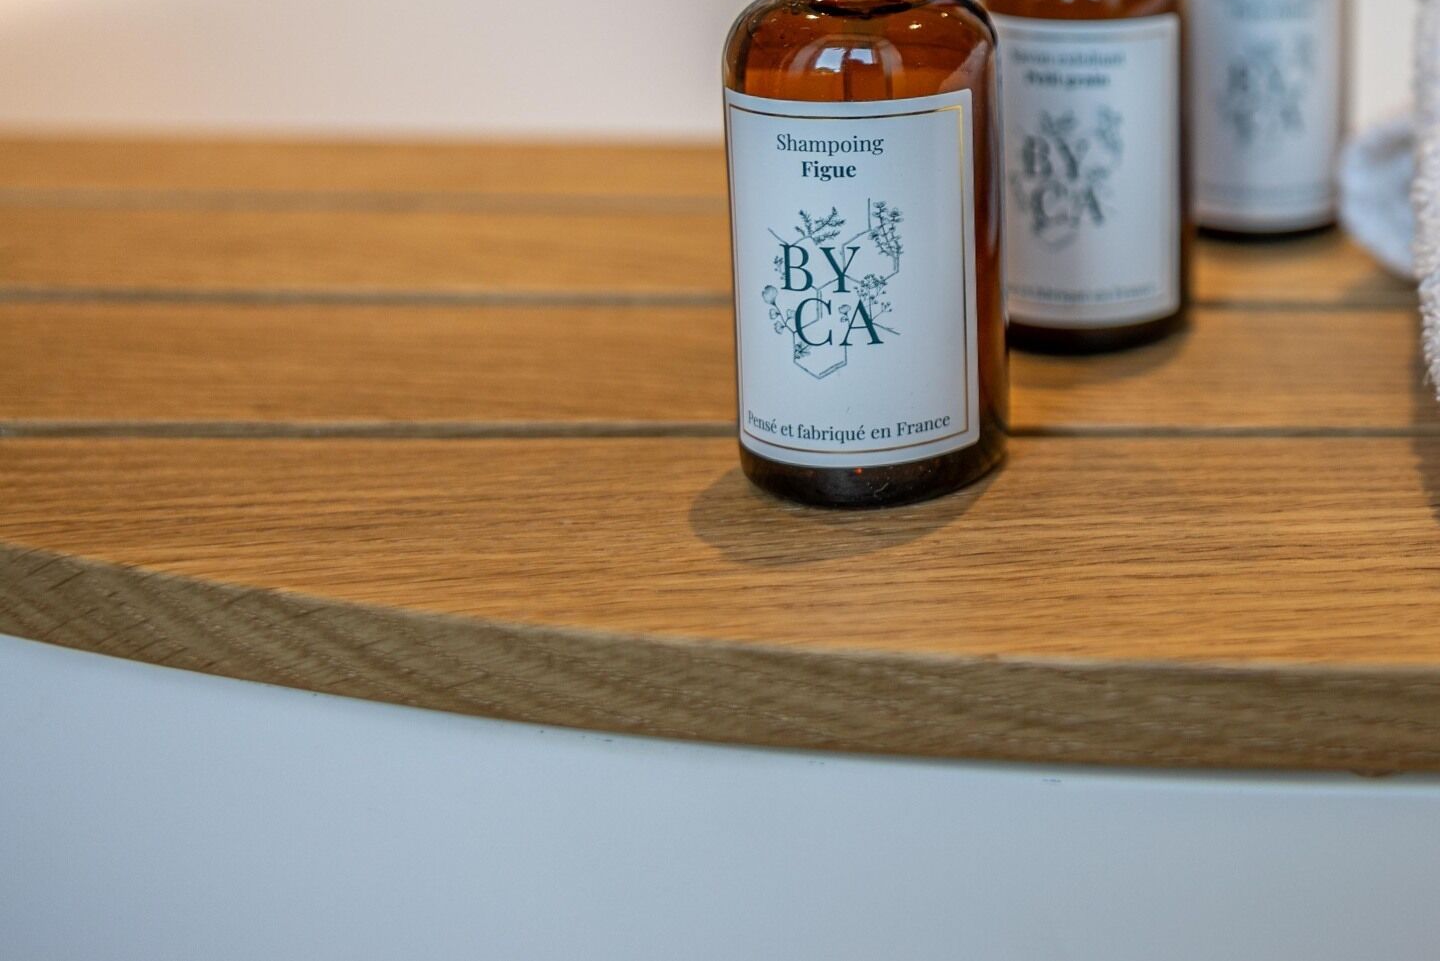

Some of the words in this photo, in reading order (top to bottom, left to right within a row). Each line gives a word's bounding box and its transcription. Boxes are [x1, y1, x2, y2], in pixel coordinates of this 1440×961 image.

[776, 132, 885, 157] Shampoing
[800, 159, 857, 182] Figue
[779, 243, 861, 293] BY
[794, 298, 884, 347] CA
[747, 410, 777, 434] Pensé
[781, 423, 793, 438] et
[798, 423, 865, 444] fabriqué
[871, 426, 891, 439] en
[897, 415, 951, 437] France
